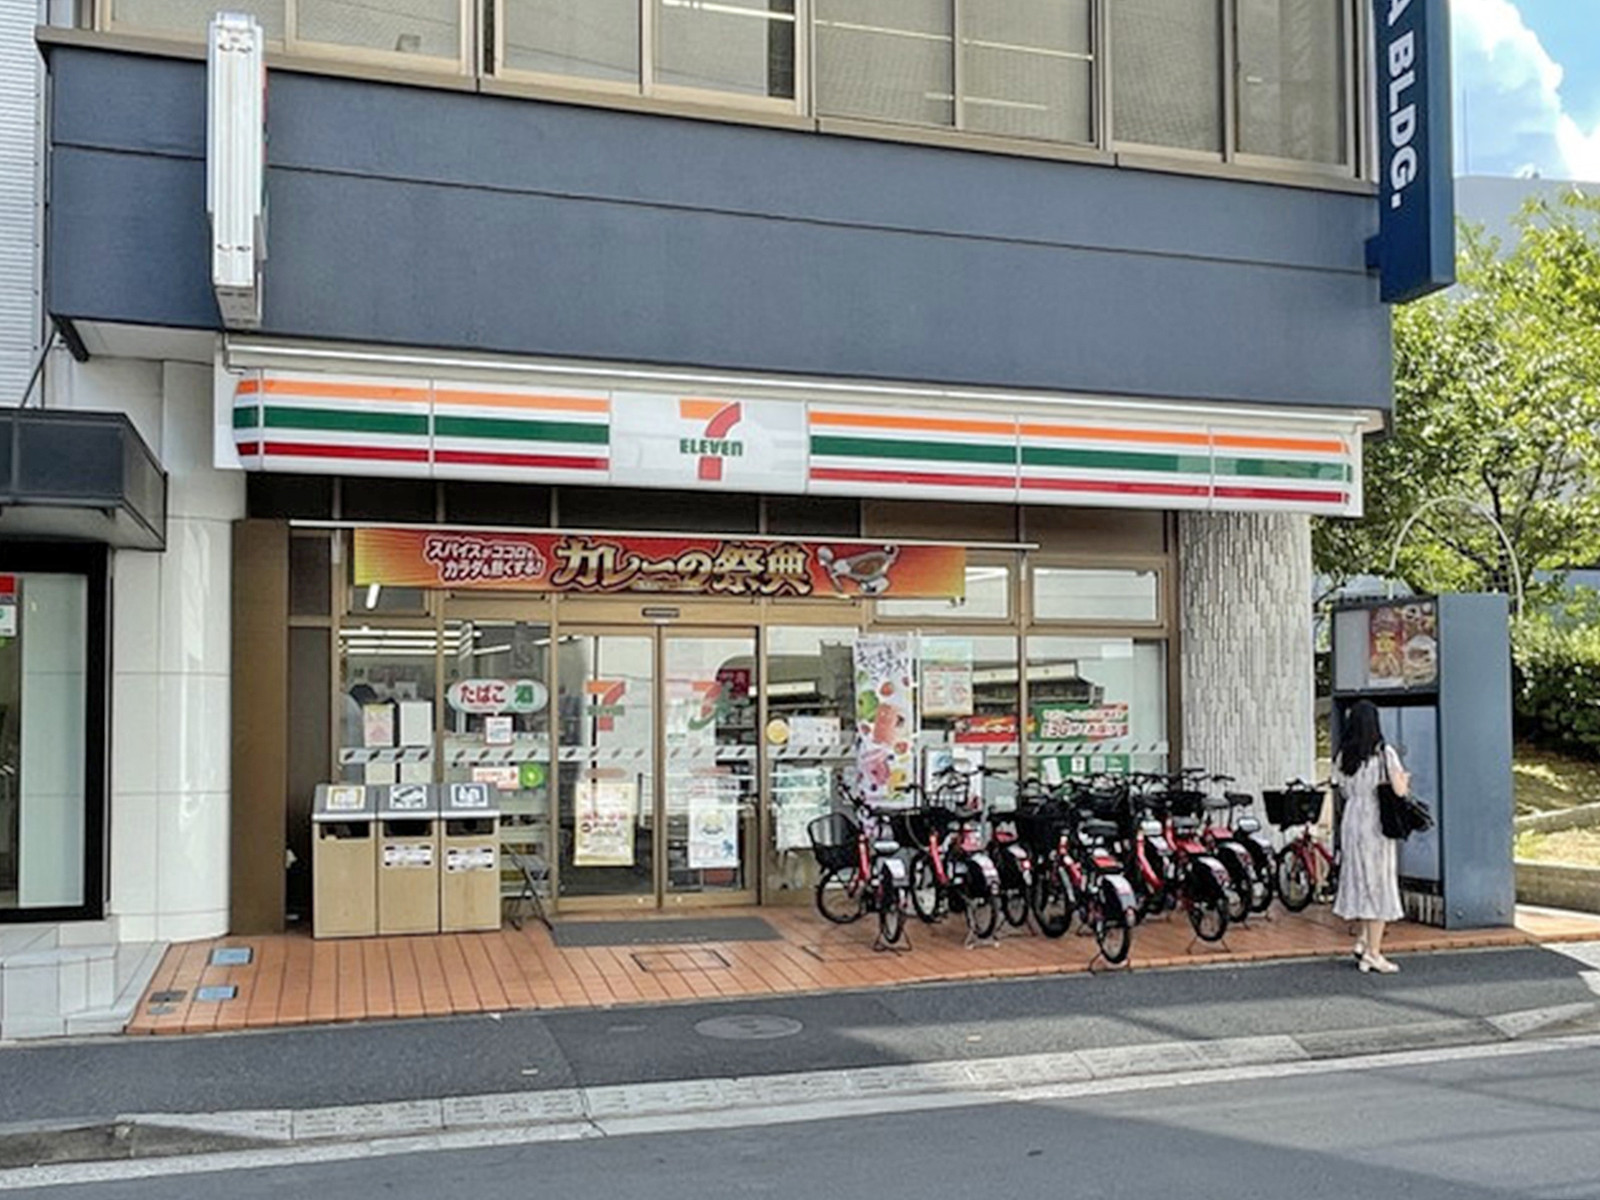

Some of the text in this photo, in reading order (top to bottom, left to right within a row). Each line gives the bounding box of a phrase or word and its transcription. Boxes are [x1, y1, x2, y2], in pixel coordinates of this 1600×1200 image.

[1389, 31, 1417, 208] BLDG.
[552, 538, 812, 594] カレーの祭典
[461, 684, 506, 704] たばこ
